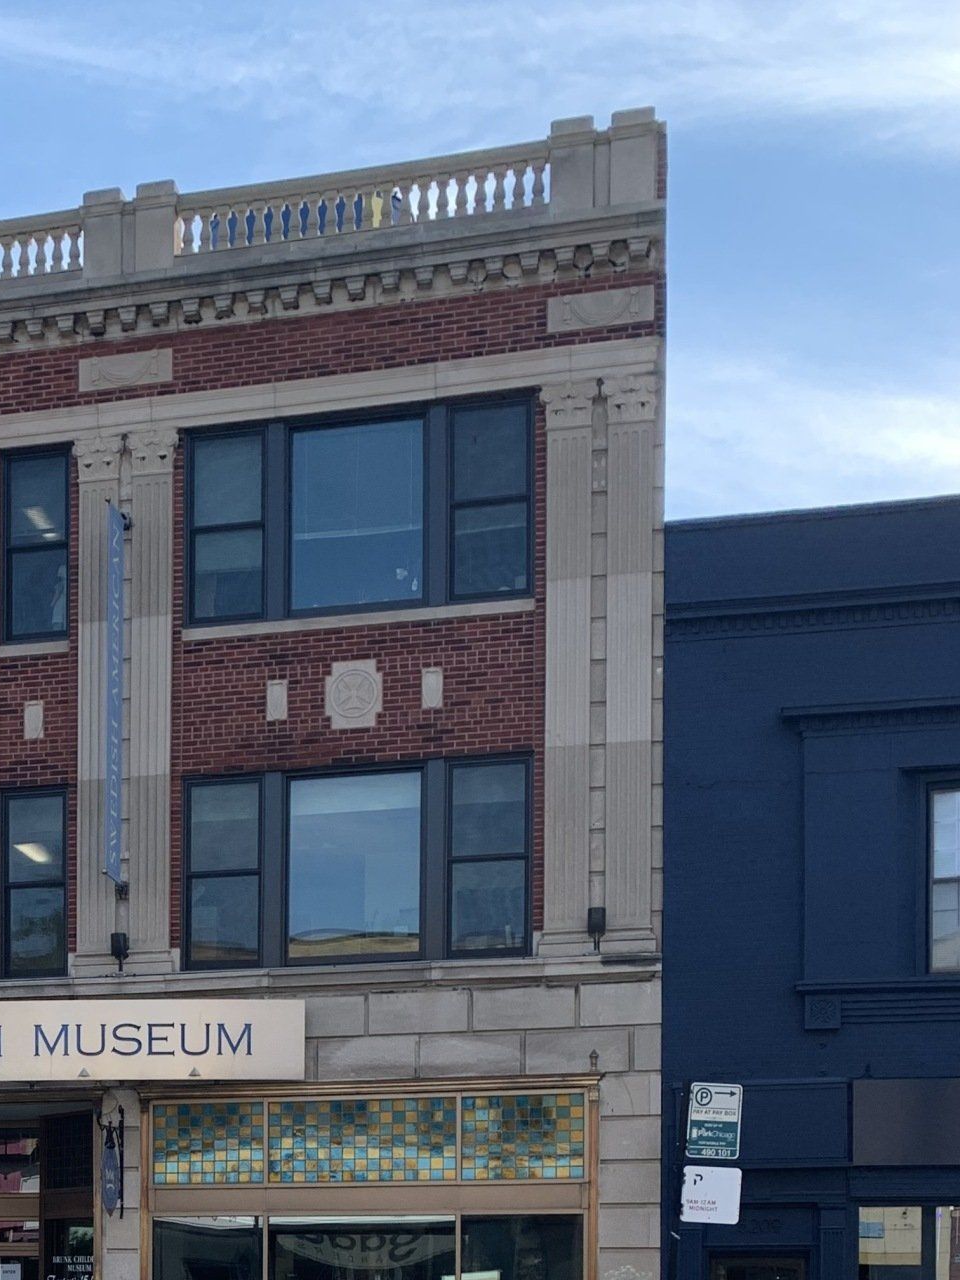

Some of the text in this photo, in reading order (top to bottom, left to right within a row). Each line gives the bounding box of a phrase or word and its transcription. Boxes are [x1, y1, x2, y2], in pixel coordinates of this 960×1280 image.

[109, 526, 120, 868] SWEDISH AMERICAN
[33, 1022, 254, 1058] MUSEUM
[718, 1149, 731, 1157] 101
[68, 1264, 92, 1272] MUSEUM
